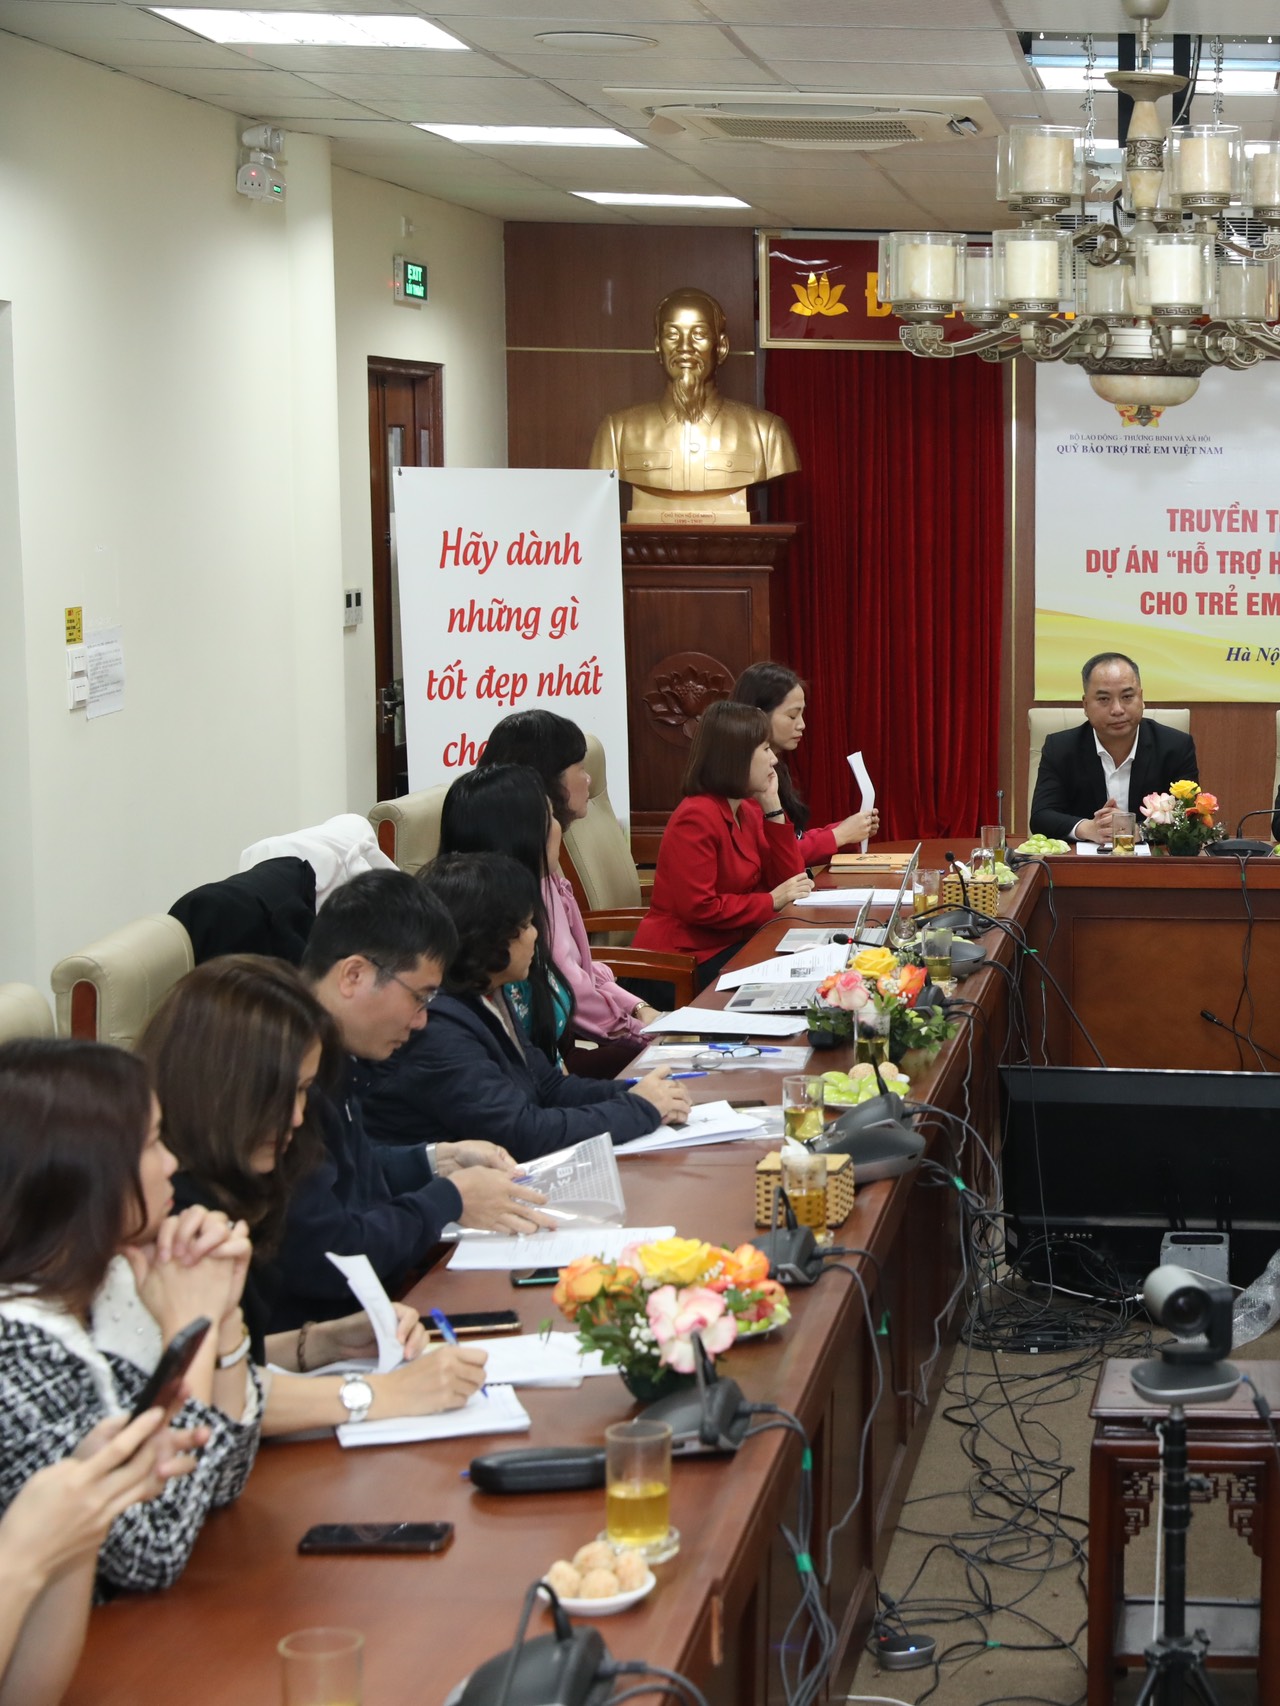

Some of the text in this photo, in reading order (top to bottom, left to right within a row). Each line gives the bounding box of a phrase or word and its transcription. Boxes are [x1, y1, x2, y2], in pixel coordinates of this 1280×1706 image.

[407, 264, 423, 282] EXIT
[1056, 443, 1224, 457] QUỸ BẢO TRỢ TRẺ EM VIỆT NAM
[1069, 433, 1081, 441] BỘ
[1097, 433, 1119, 442] ĐỘNG
[1124, 433, 1154, 442] THƯƠNG
[1155, 434, 1173, 442] BINH
[1174, 433, 1185, 442] VÀ
[1185, 433, 1197, 442] XÃ
[1198, 433, 1211, 442] HỘI
[1166, 501, 1258, 533] TRUYỀN
[439, 527, 582, 575] Hãy dành
[1085, 547, 1120, 579] DỰ
[1125, 545, 1159, 574] ÁN
[1216, 549, 1262, 580] TRỢ
[1140, 591, 1188, 616] CHO
[1195, 584, 1238, 616] TRẺ
[447, 595, 579, 640] những gì
[1226, 647, 1251, 662] Hà
[427, 656, 604, 707] tốt đẹp nhất
